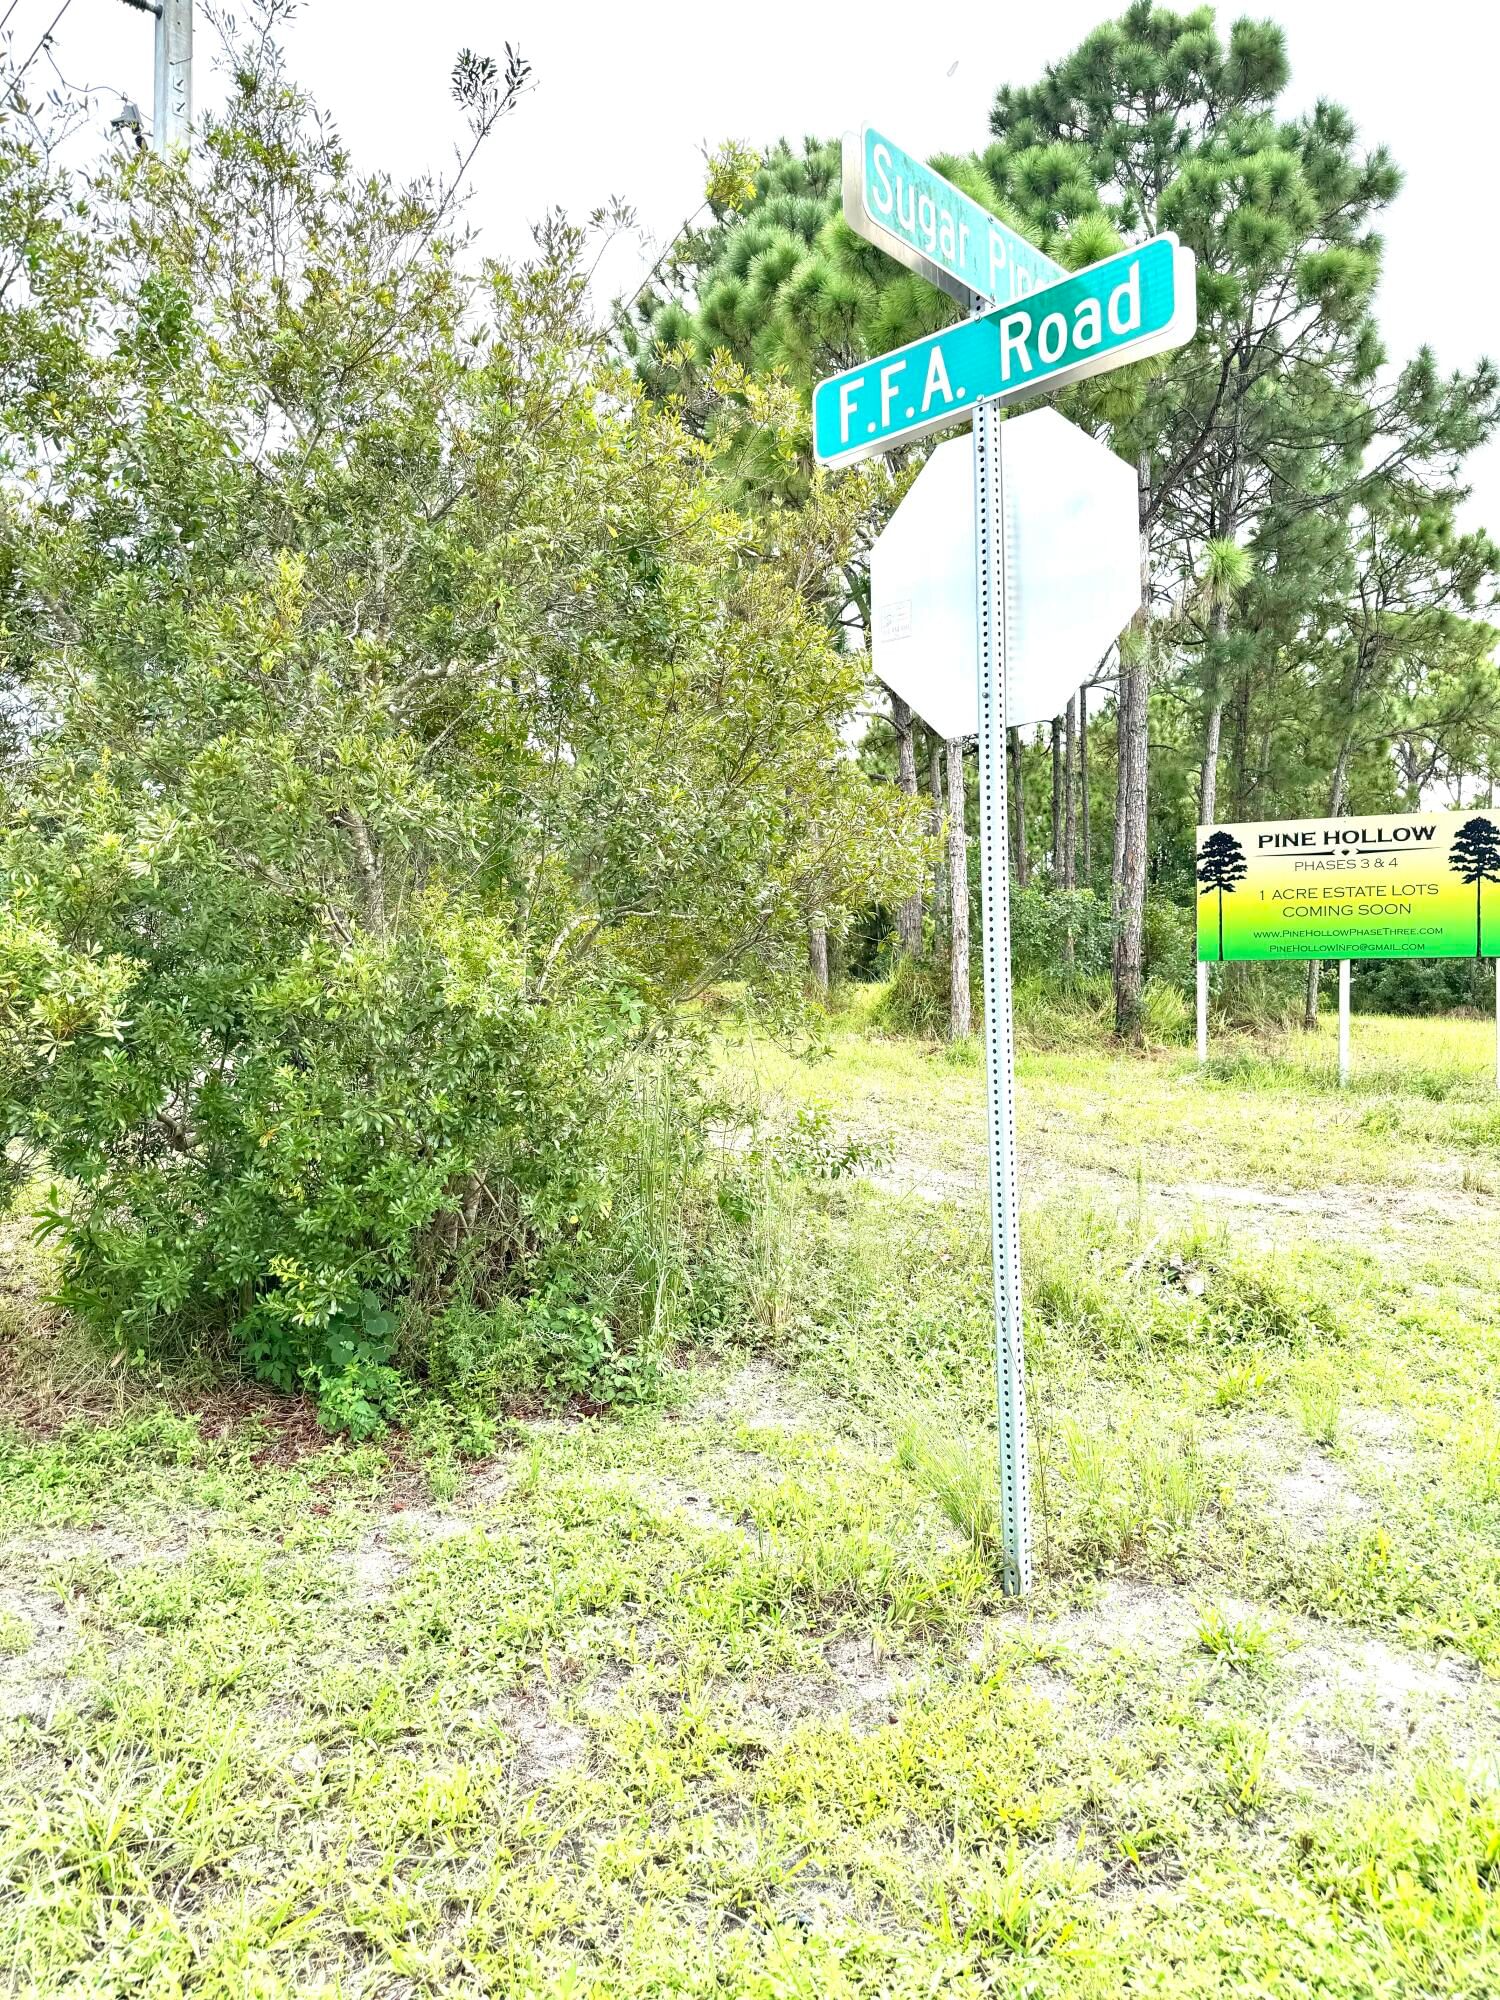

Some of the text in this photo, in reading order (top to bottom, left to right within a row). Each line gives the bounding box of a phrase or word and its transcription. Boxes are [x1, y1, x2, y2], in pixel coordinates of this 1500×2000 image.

[873, 143, 1047, 299] Sugar Pin
[839, 260, 1142, 444] F.F.A. Road
[1258, 825, 1437, 849] PINE HOLLOW
[1294, 857, 1398, 872] PHASES 3 & 4
[1260, 883, 1439, 901] 1 ACRE ESTATE LOTS
[1282, 903, 1411, 918] COMING SOON
